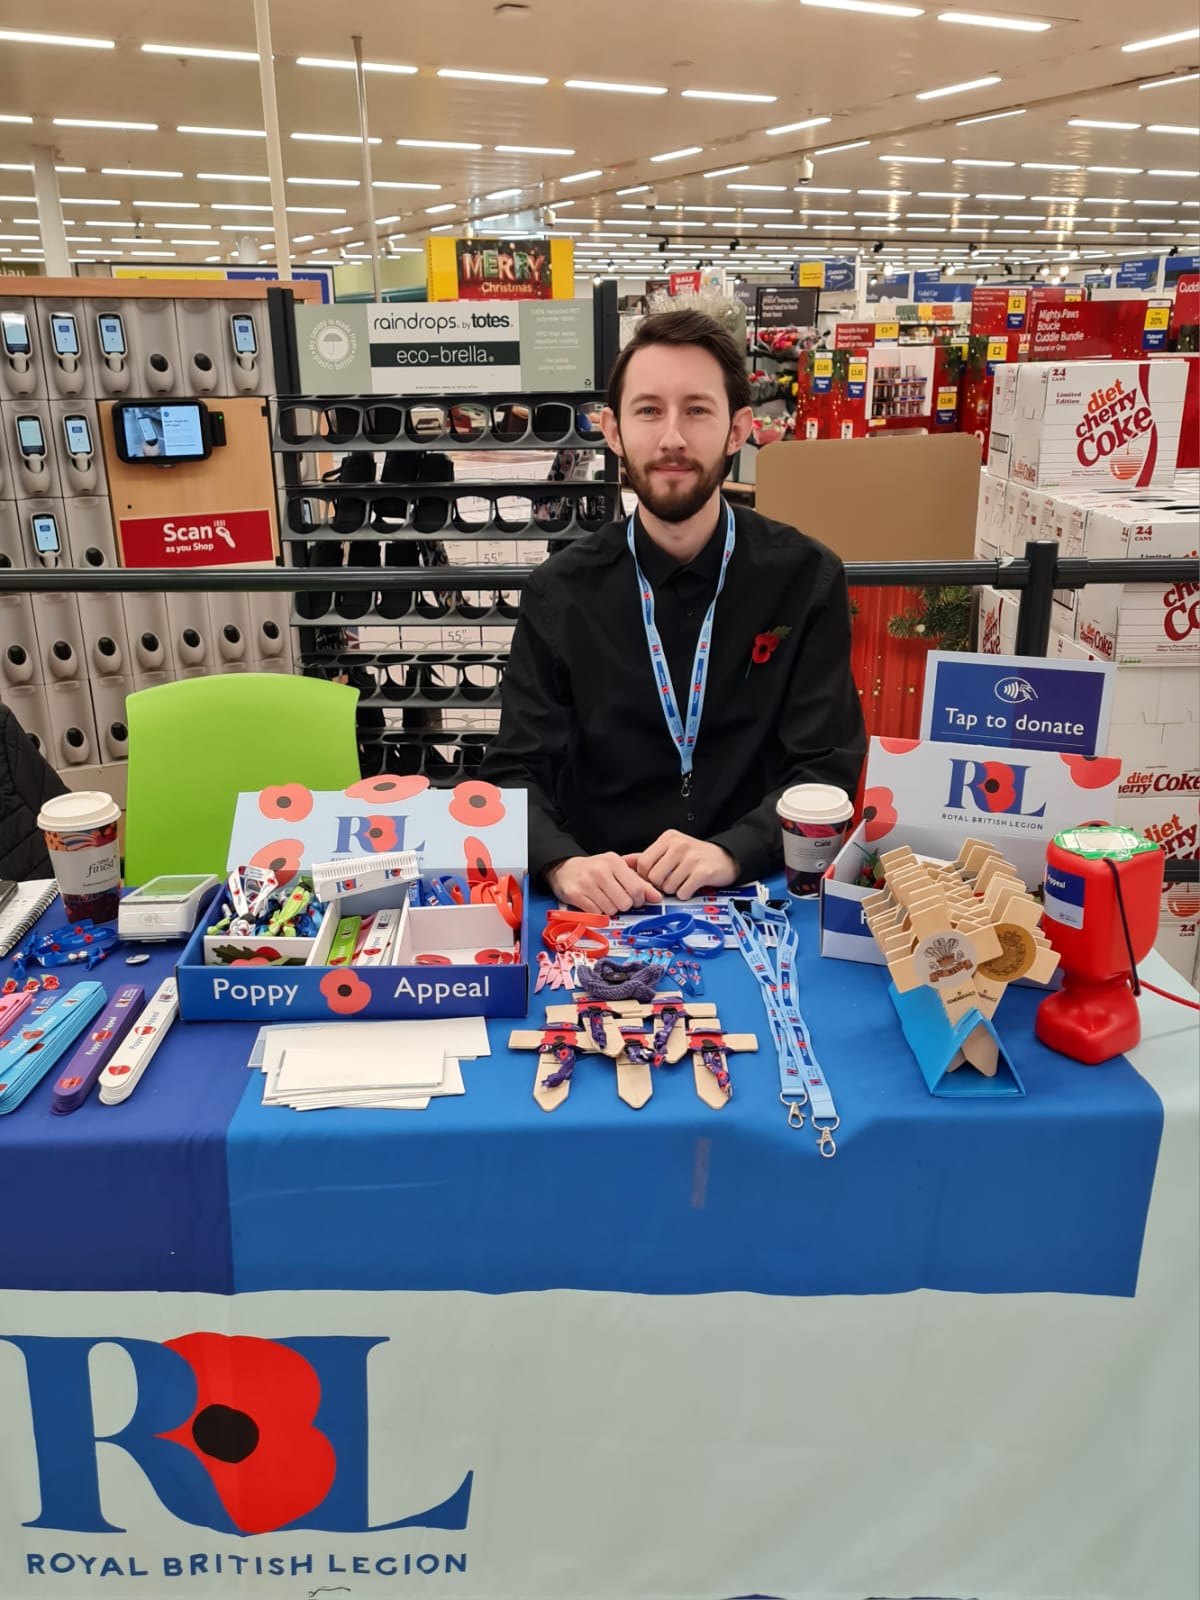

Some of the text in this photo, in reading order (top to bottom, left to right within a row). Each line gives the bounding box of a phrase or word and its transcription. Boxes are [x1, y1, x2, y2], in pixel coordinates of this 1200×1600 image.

[462, 250, 545, 280] MERRY
[481, 281, 533, 293] Christmas
[1039, 310, 1061, 321] Mighty
[462, 321, 471, 331] by
[1037, 321, 1061, 331] Boucle
[1035, 331, 1085, 343] Cuddle Bundle
[1053, 367, 1067, 377] 24
[1088, 379, 1126, 414] diet
[1076, 388, 1138, 438] cherry
[1077, 406, 1152, 467] Coke
[163, 522, 213, 542] Scan
[1135, 525, 1153, 536] 24
[165, 538, 215, 554] as you Shop
[945, 707, 1085, 736] Tap to donate
[1127, 771, 1154, 785] diet
[1118, 783, 1153, 796] erry
[941, 813, 1044, 831] ROYAL BRITISH LEGION
[1180, 923, 1196, 933] 24
[213, 975, 490, 1007] Poppy Appeal
[26, 1553, 467, 1577] ROYAL BRITISH LEGION
